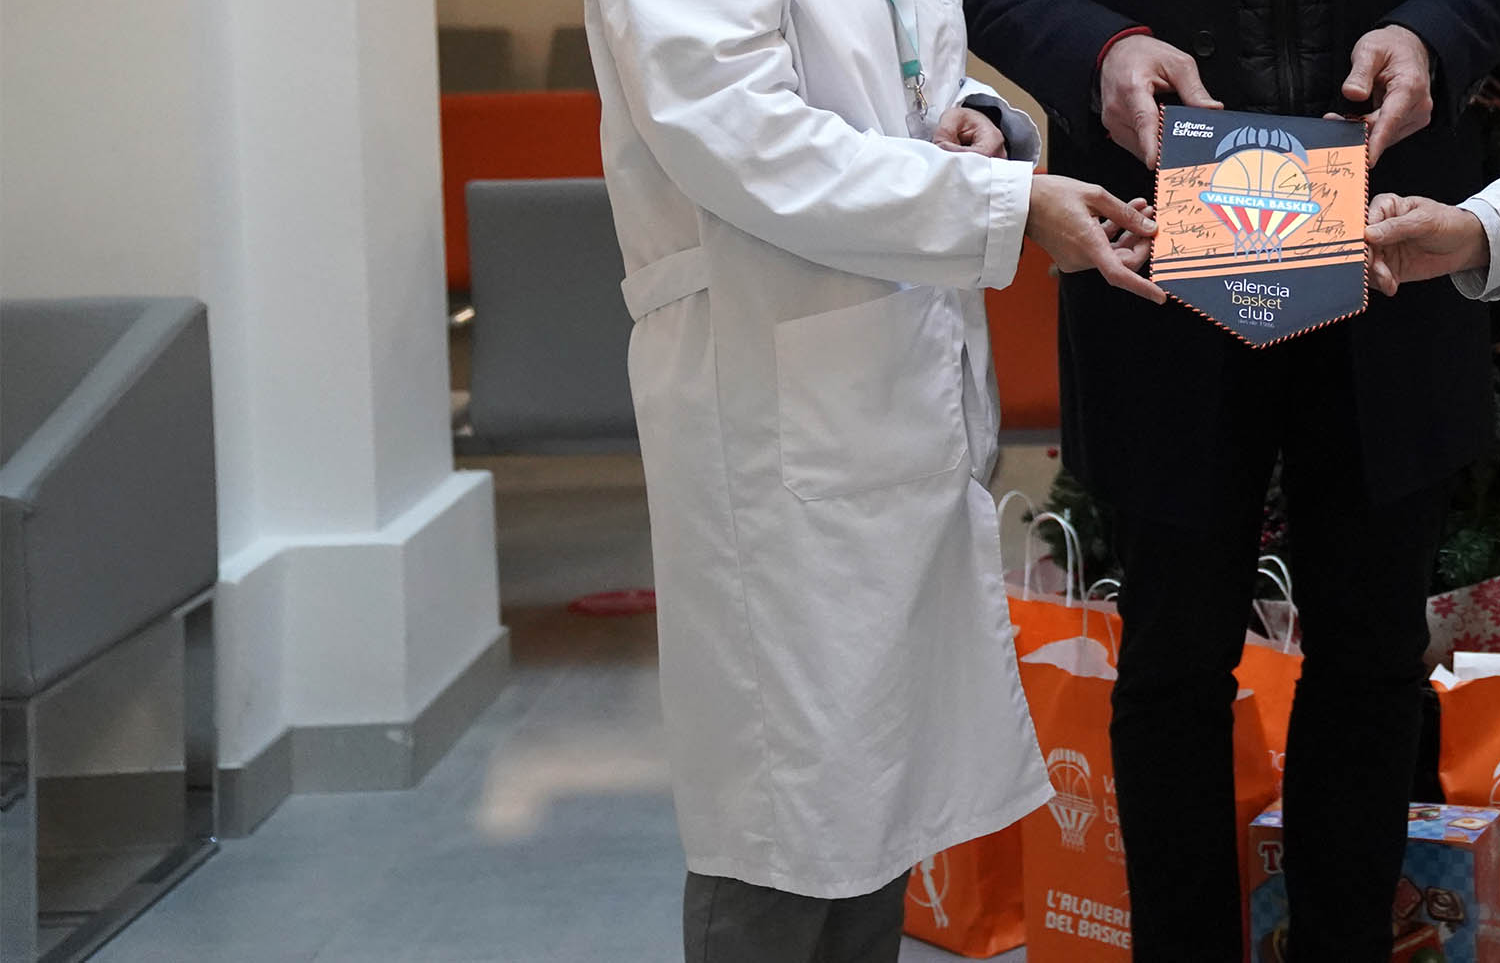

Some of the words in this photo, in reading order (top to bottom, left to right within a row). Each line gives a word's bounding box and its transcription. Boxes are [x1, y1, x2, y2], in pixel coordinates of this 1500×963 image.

[1172, 128, 1214, 139] Esfuerzo
[1174, 120, 1206, 130] Cultura
[1206, 192, 1265, 209] VALENCIA
[1268, 199, 1314, 214] BASKET
[1223, 278, 1290, 298] valencia
[1231, 290, 1282, 311] basket
[1238, 305, 1274, 322] club
[1046, 889, 1131, 929] L'ALQUERI
[1045, 911, 1075, 935] DEL
[1077, 919, 1131, 951] BASKE
